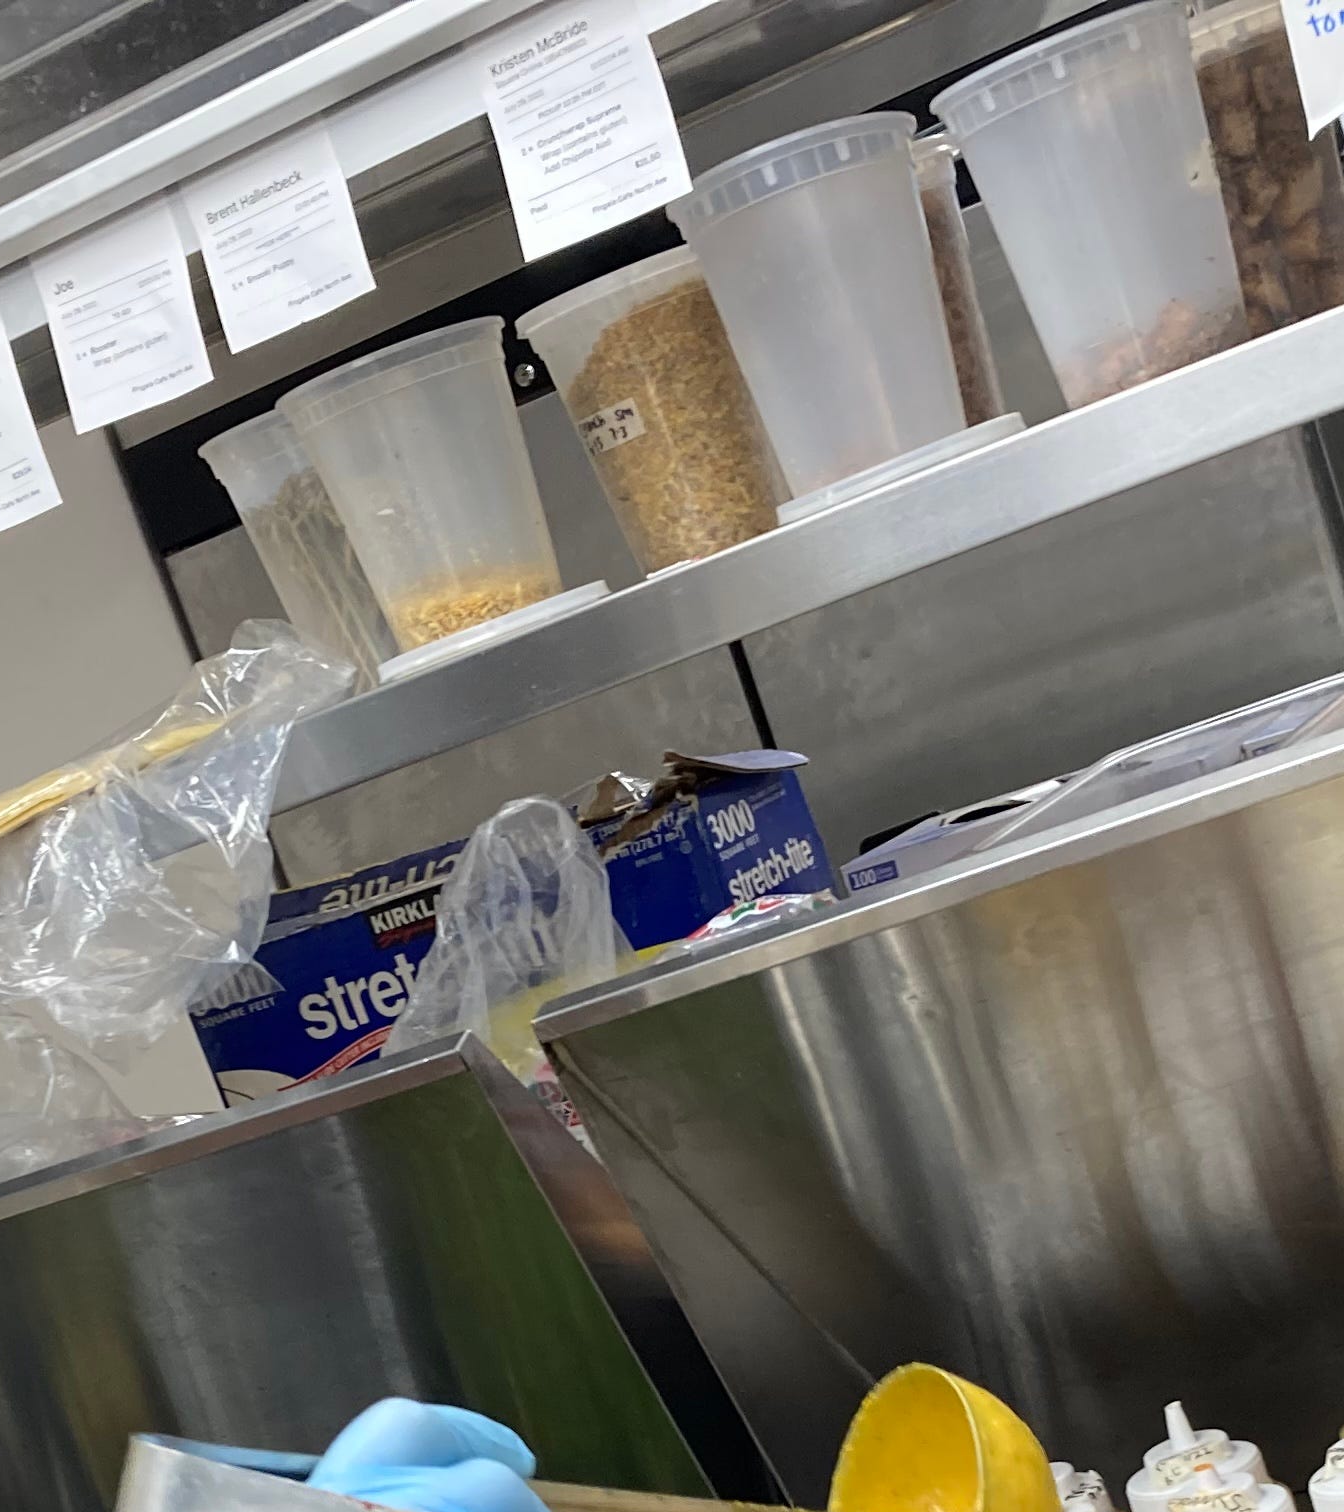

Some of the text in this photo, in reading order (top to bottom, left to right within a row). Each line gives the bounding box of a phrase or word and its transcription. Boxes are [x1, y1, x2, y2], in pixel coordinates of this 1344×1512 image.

[490, 48, 535, 77] Kristen
[536, 19, 588, 55] McBride
[206, 202, 240, 225] Brent
[240, 170, 304, 209] Hallenbeck
[54, 279, 74, 295] Joe
[707, 799, 755, 849] 3000
[728, 837, 815, 903] stretch-tite
[851, 869, 877, 889] 100
[370, 894, 442, 934] KIRKL
[199, 997, 276, 1029] SQUARE FEET
[299, 953, 418, 1039] stret
